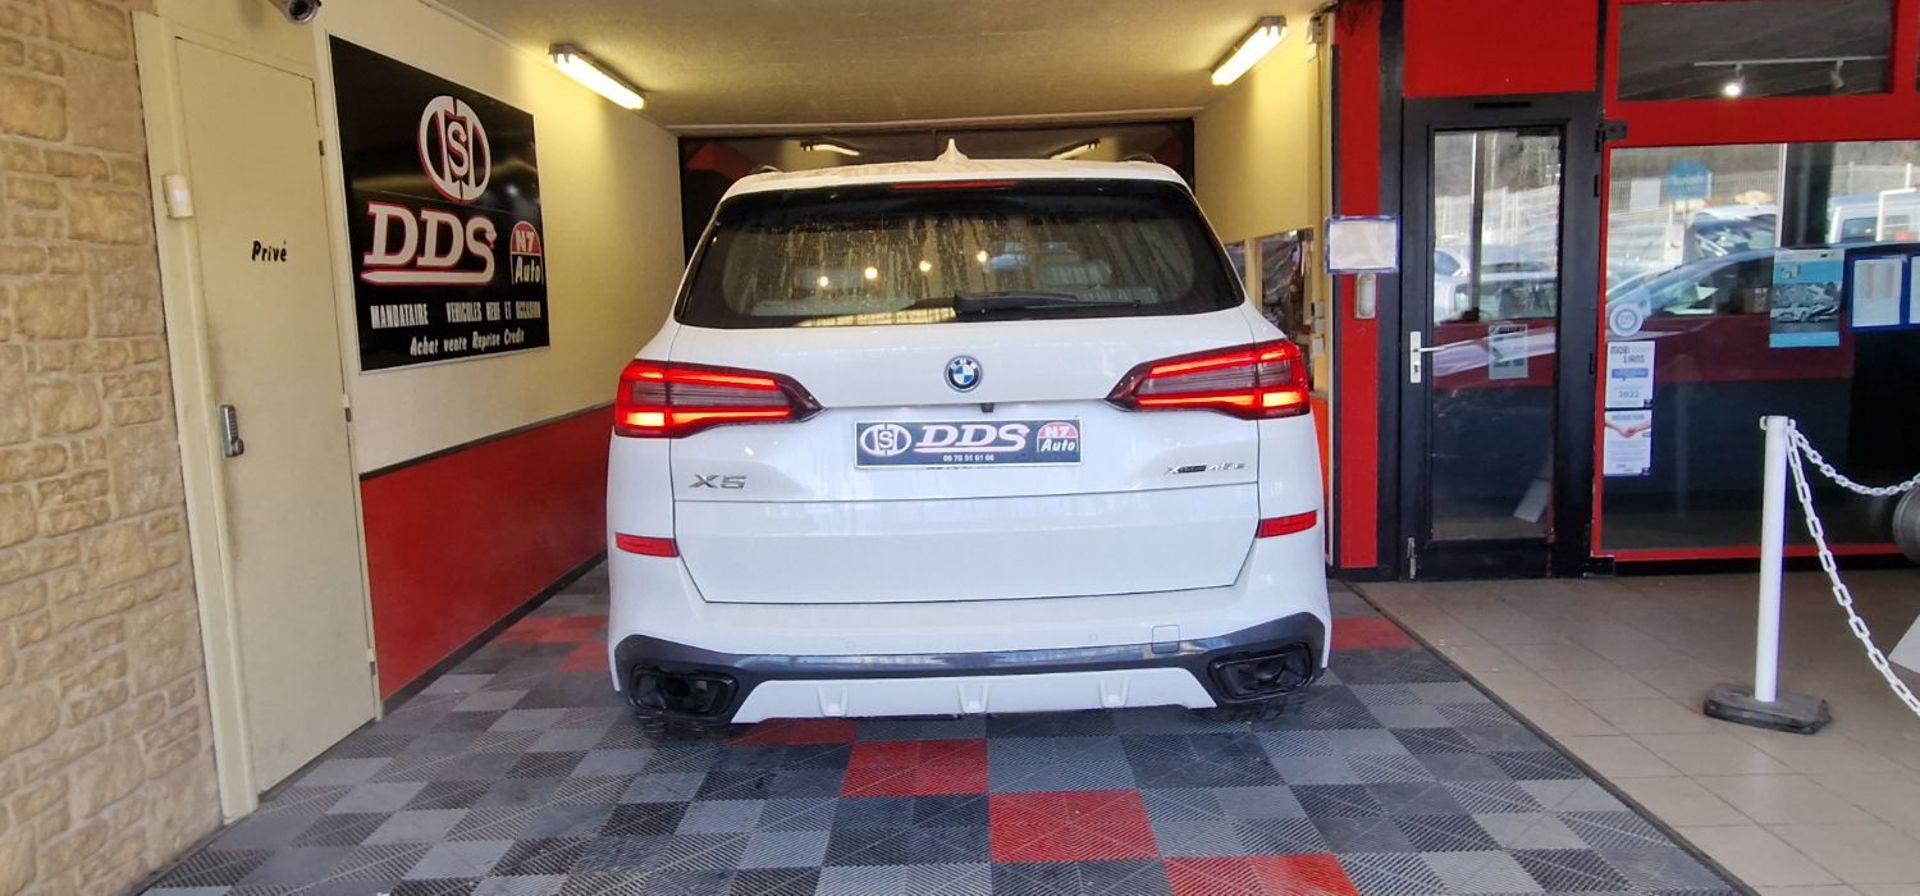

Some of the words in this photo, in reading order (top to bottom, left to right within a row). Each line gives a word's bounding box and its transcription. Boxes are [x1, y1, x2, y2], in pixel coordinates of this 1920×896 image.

[252, 240, 287, 262] Privé
[361, 202, 497, 285] DDS
[515, 229, 535, 252] N7
[515, 256, 541, 284] Auto
[370, 303, 429, 329] MANDATAIRE
[446, 301, 482, 323] VEHICULES
[504, 301, 512, 320] ET
[410, 336, 438, 356] Achat
[443, 337, 467, 352] vente
[472, 331, 500, 352] Reprise
[913, 423, 1030, 454] DDS
[1045, 426, 1070, 438] N7
[1041, 438, 1076, 452] Auto
[688, 474, 747, 489] X5
